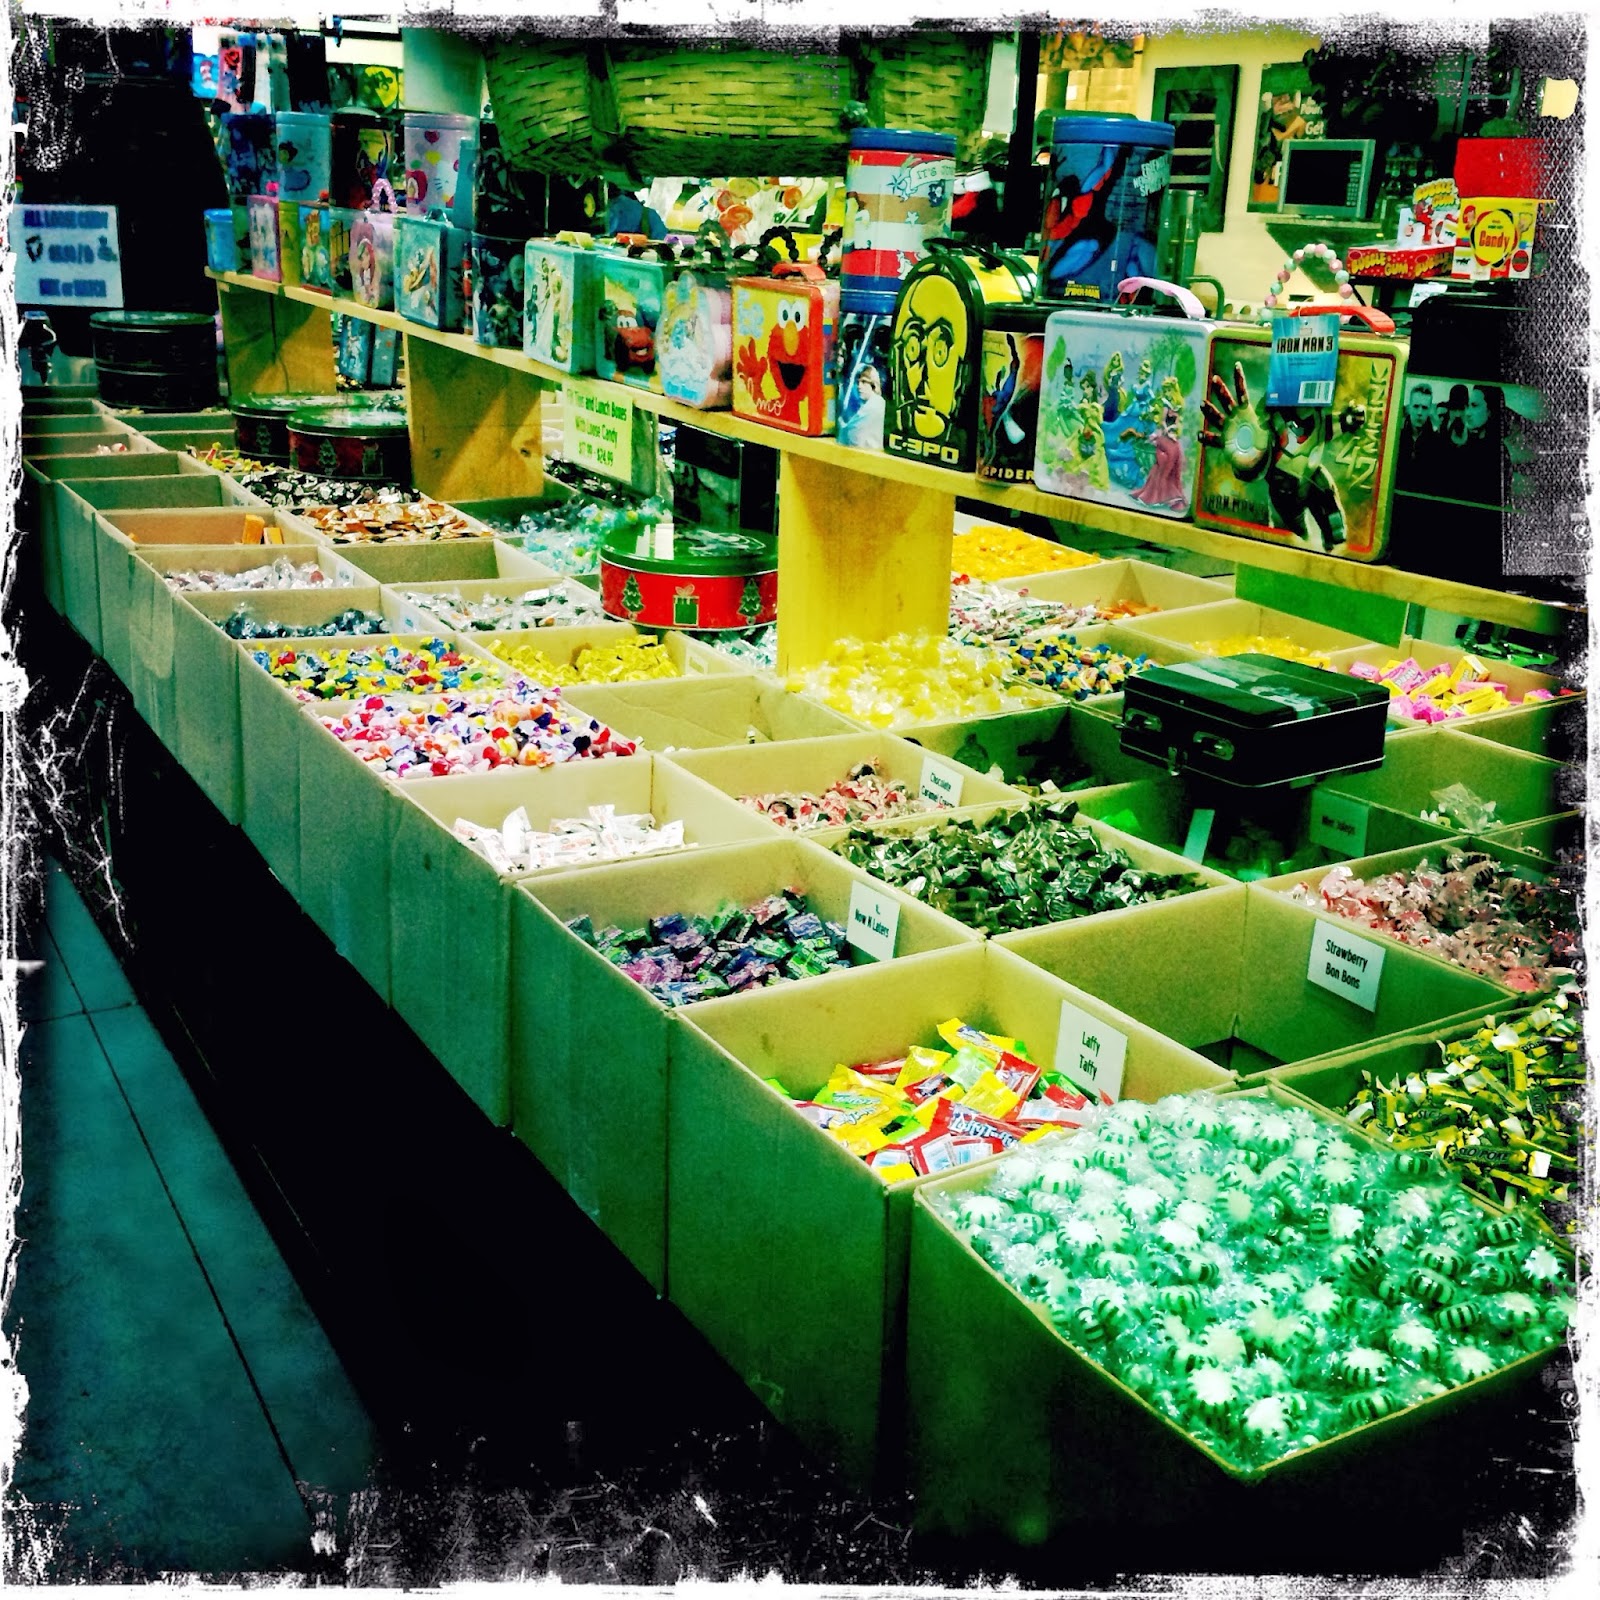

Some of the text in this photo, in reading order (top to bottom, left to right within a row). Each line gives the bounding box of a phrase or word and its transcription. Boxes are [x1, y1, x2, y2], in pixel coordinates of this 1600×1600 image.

[1478, 230, 1510, 252] Candy
[1385, 263, 1409, 276] GUM
[1276, 335, 1334, 354] IRON MAN 3
[1325, 939, 1368, 973] Strawberry
[1325, 962, 1360, 989] Bon Bons
[1082, 1031, 1100, 1057] Laffy
[1079, 1054, 1098, 1081] Taffy
